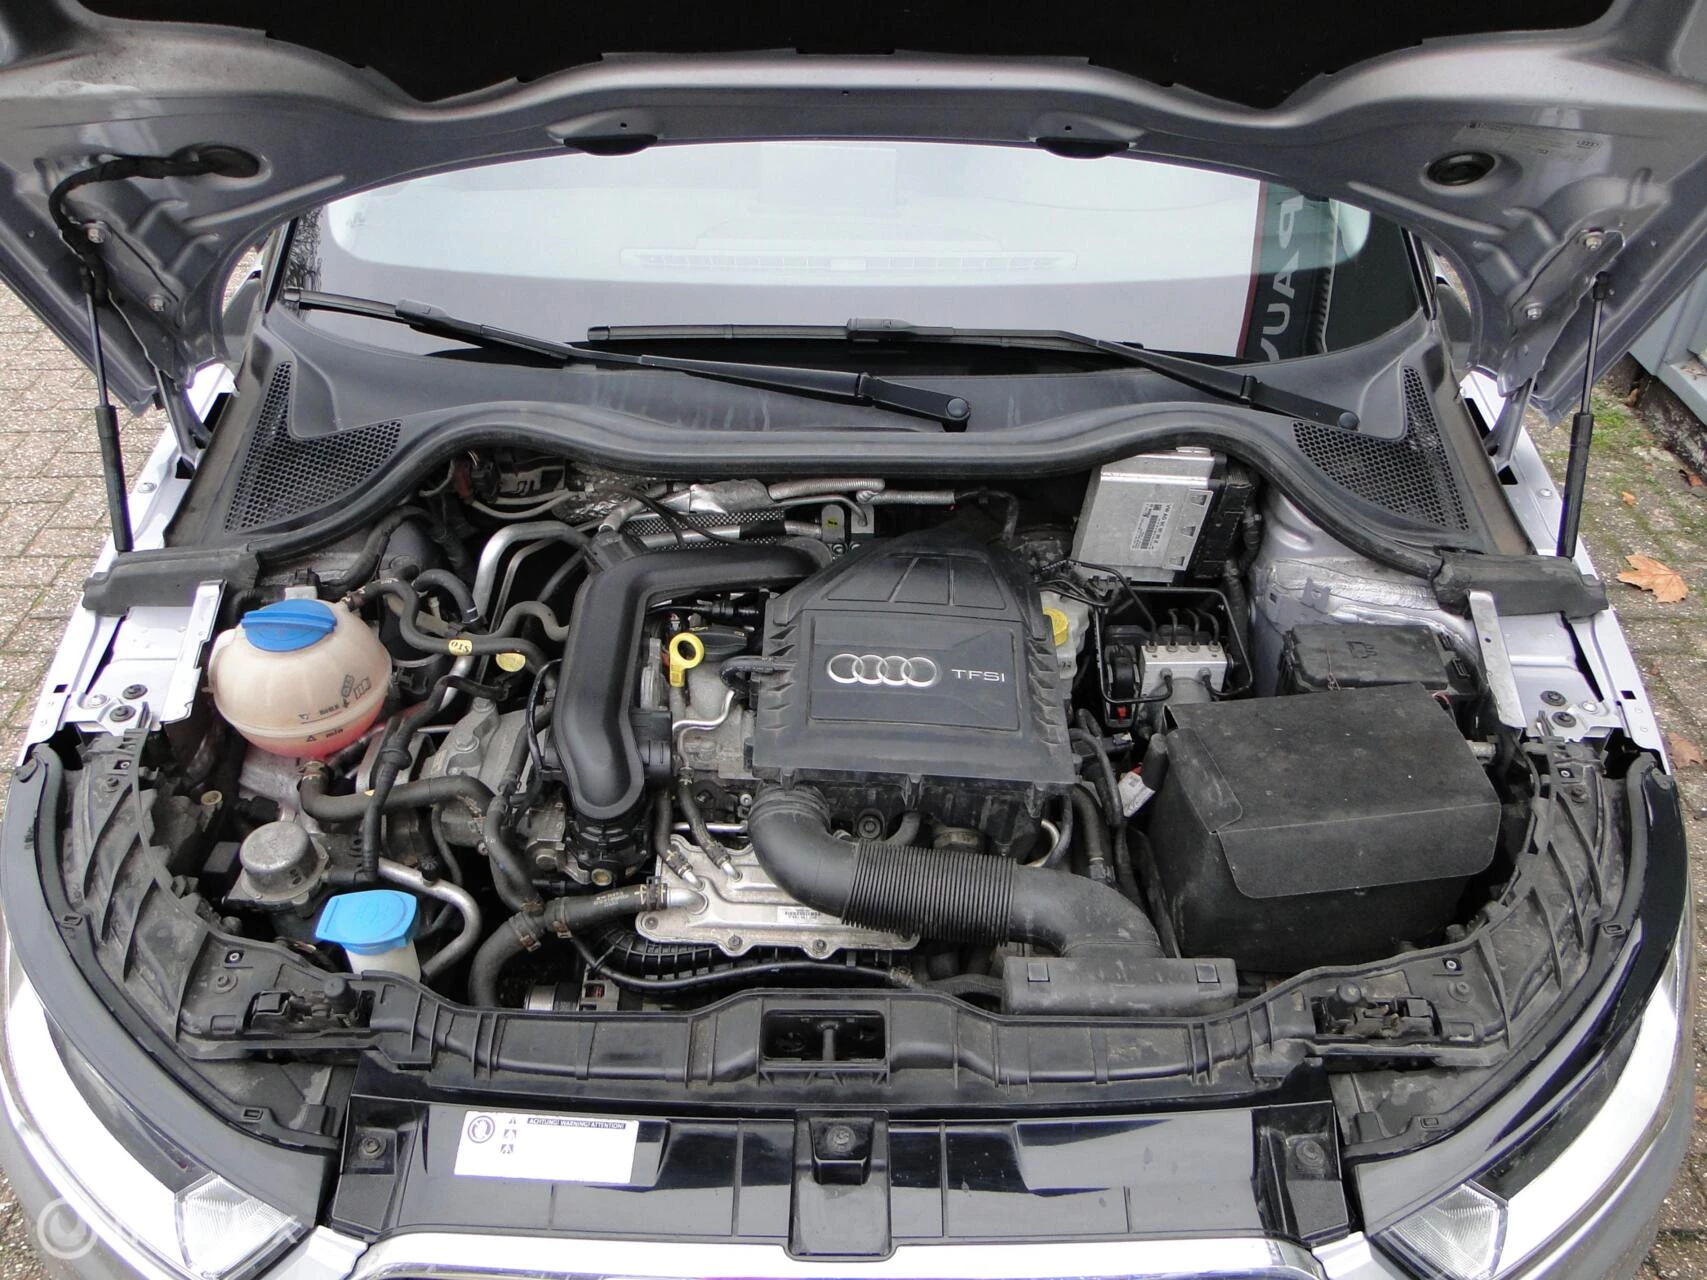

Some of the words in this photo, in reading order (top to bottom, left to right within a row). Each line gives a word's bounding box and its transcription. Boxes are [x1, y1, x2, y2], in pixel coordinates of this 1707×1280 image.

[951, 669, 1005, 682] TFSI
[560, 1120, 590, 1128] WARNING!
[590, 1121, 625, 1129] ATTENTION!
